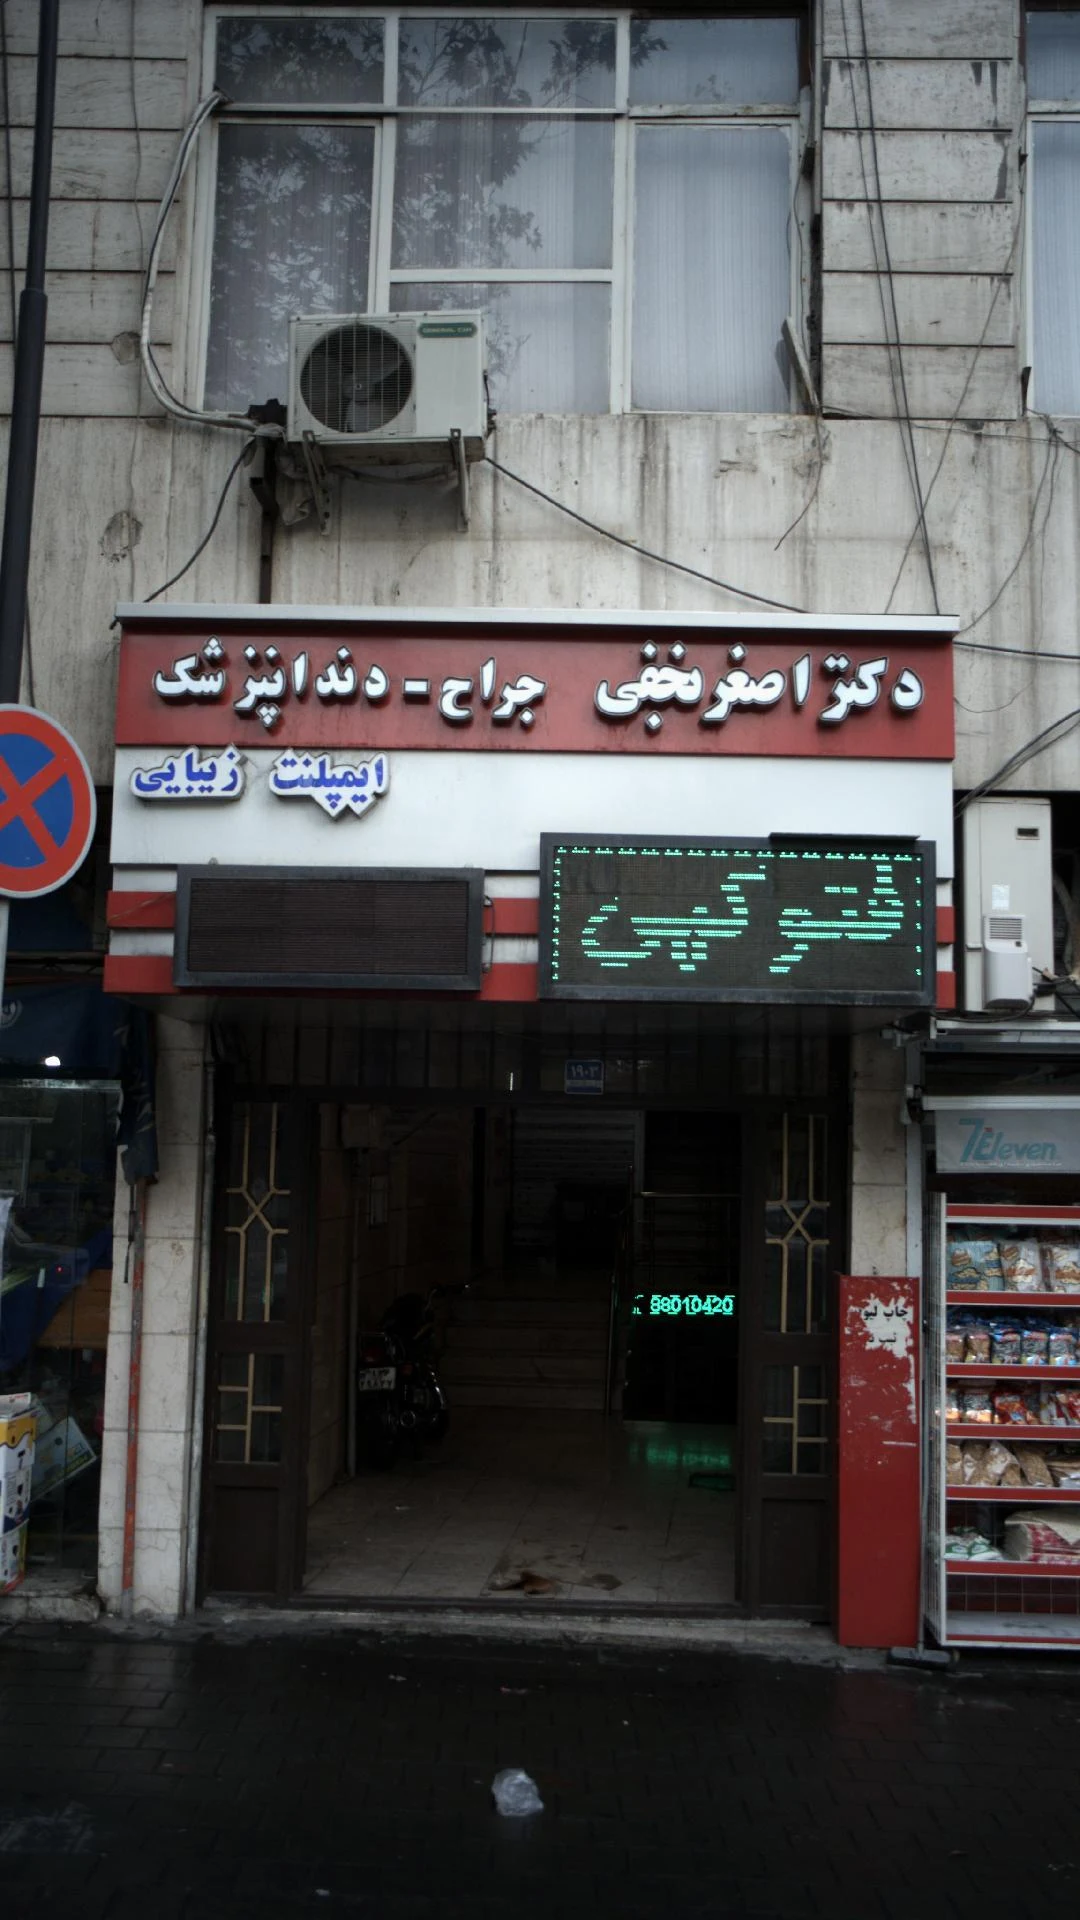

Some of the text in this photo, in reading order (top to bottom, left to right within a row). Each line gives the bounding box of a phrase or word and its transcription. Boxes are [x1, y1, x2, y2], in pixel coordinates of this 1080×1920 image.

[153, 635, 390, 728] دندانپزشک
[437, 656, 547, 726] جراح
[595, 640, 704, 732] نجفی
[699, 642, 811, 722] اصغر
[818, 652, 924, 723] دکتر
[132, 748, 388, 812] ایمپلنت زیبایی
[650, 1296, 734, 1313] 88010420
[883, 1305, 909, 1322] چاپ
